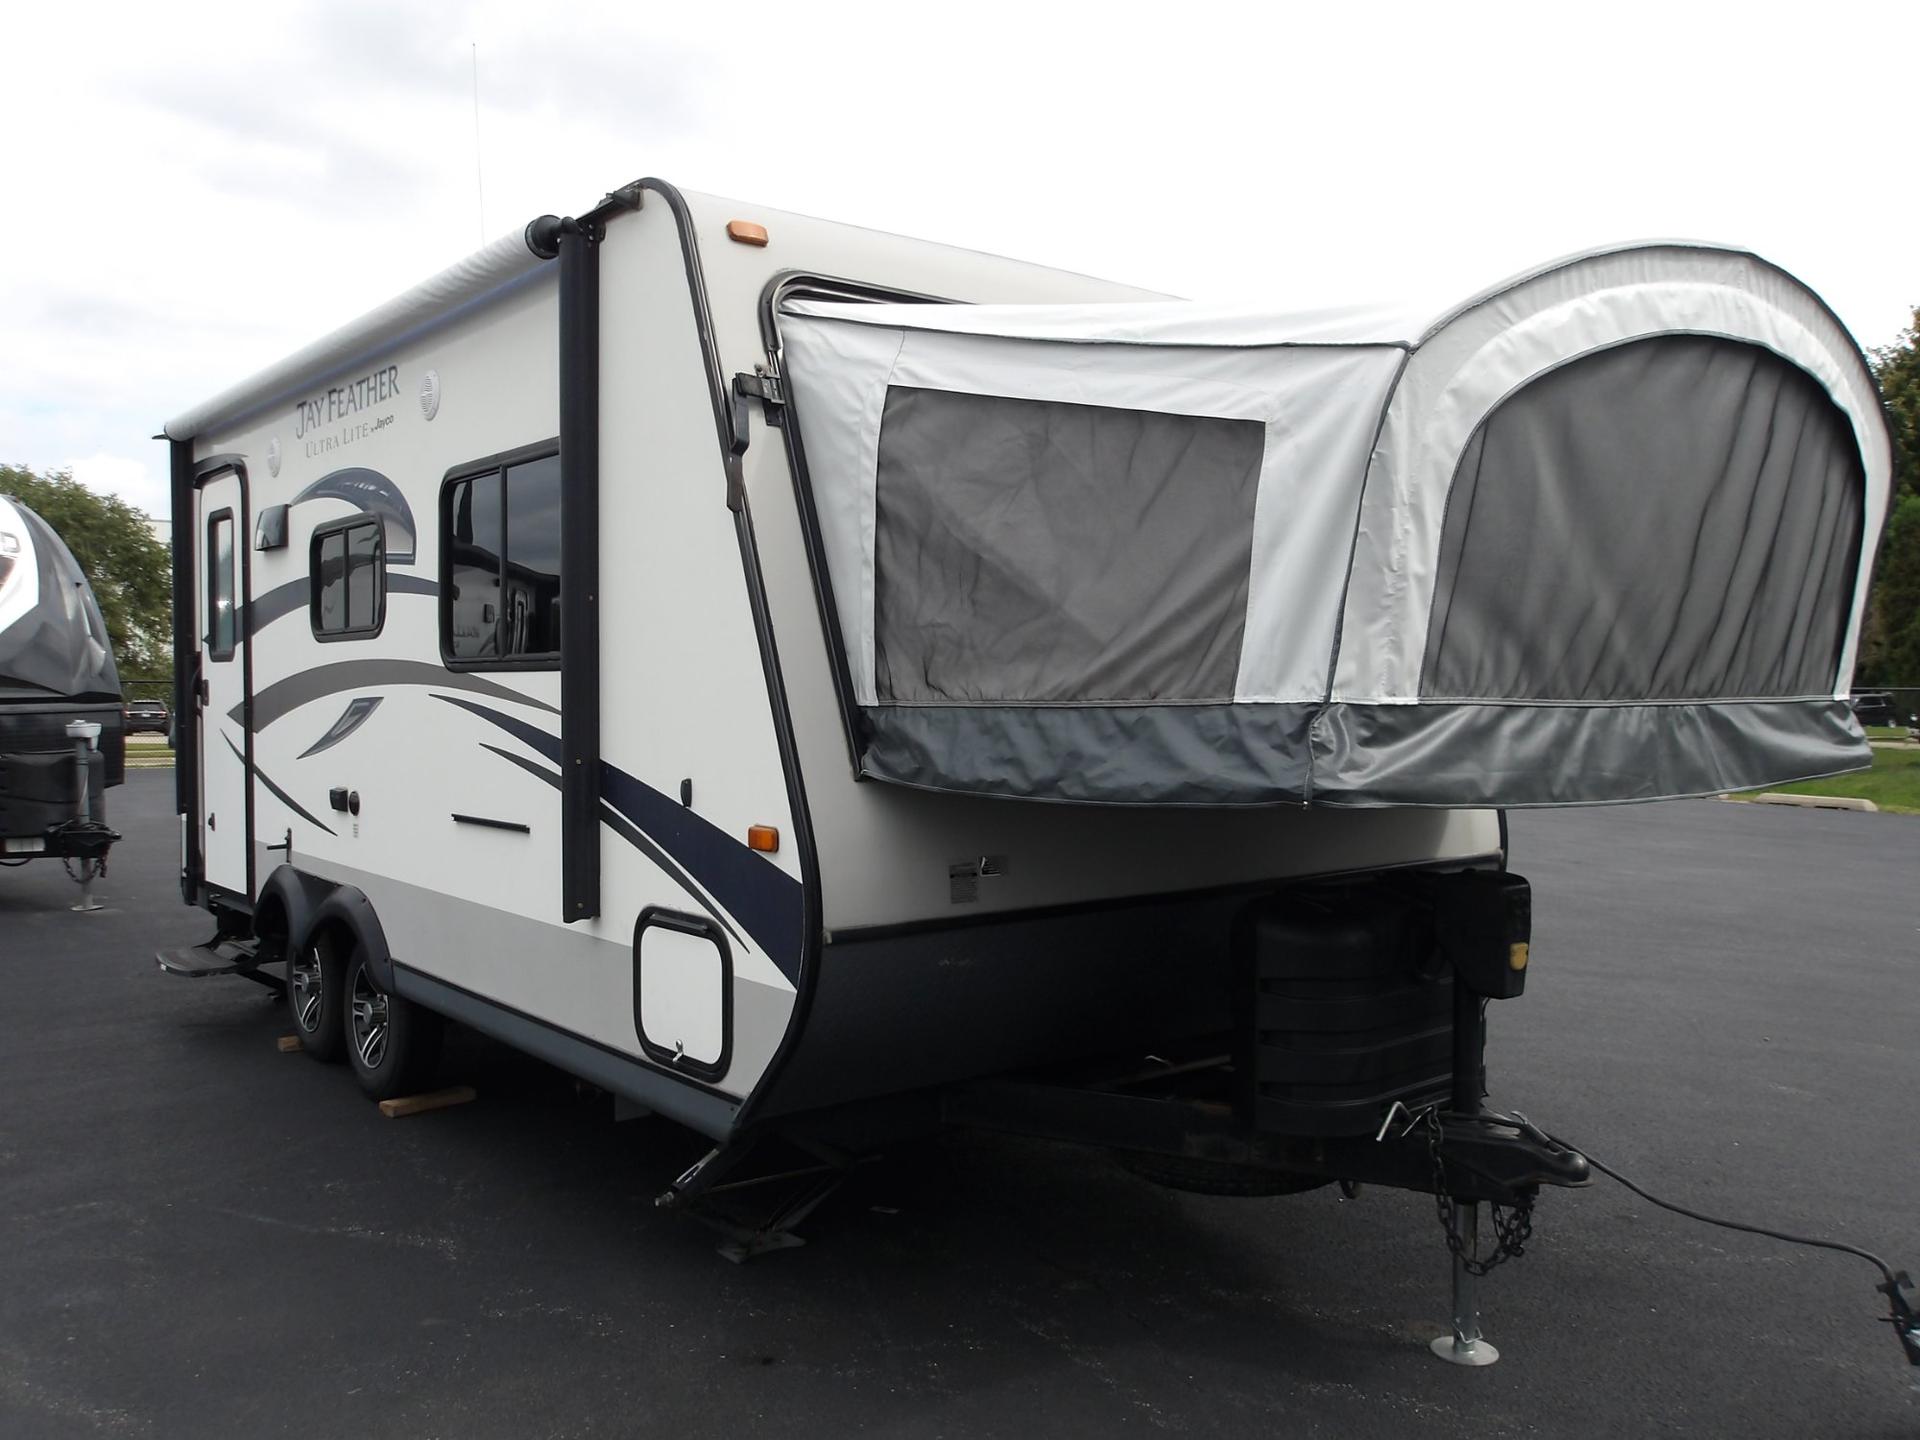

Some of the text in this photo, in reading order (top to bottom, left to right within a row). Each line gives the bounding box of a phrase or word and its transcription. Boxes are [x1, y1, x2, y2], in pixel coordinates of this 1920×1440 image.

[296, 365, 400, 440] JAY FEATHER
[305, 414, 394, 458] ULTRA LITE Jayco
